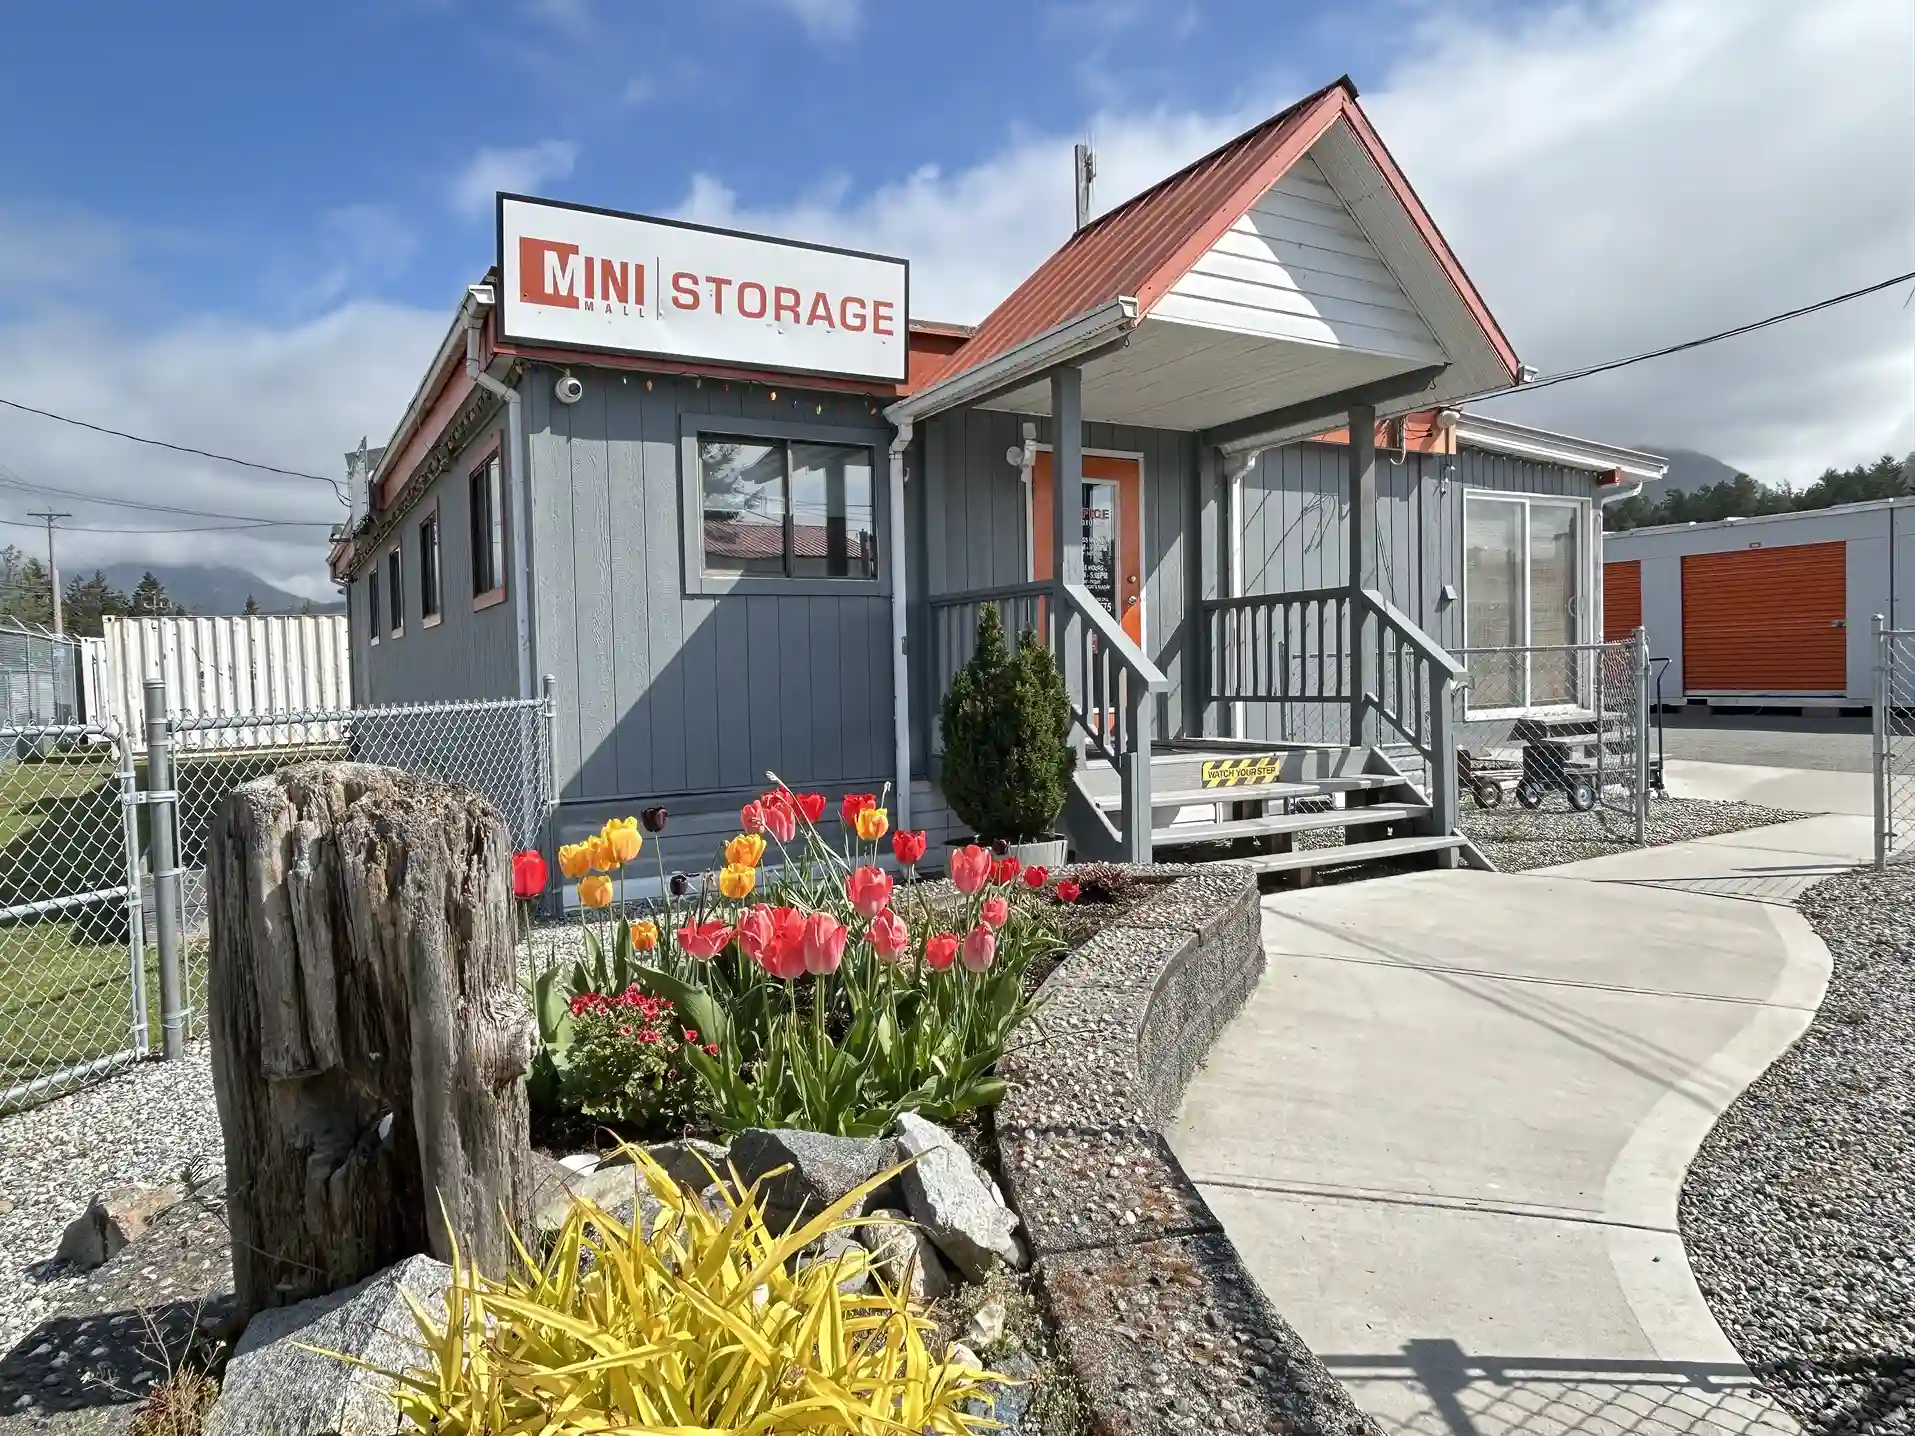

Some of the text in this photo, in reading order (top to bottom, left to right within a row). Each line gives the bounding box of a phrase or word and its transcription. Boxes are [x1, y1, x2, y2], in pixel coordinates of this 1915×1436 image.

[543, 249, 645, 306] MINI
[584, 300, 645, 318] MALL
[671, 271, 894, 336] STORAGE
[1208, 767, 1275, 778] WATCH YOUR STEP
